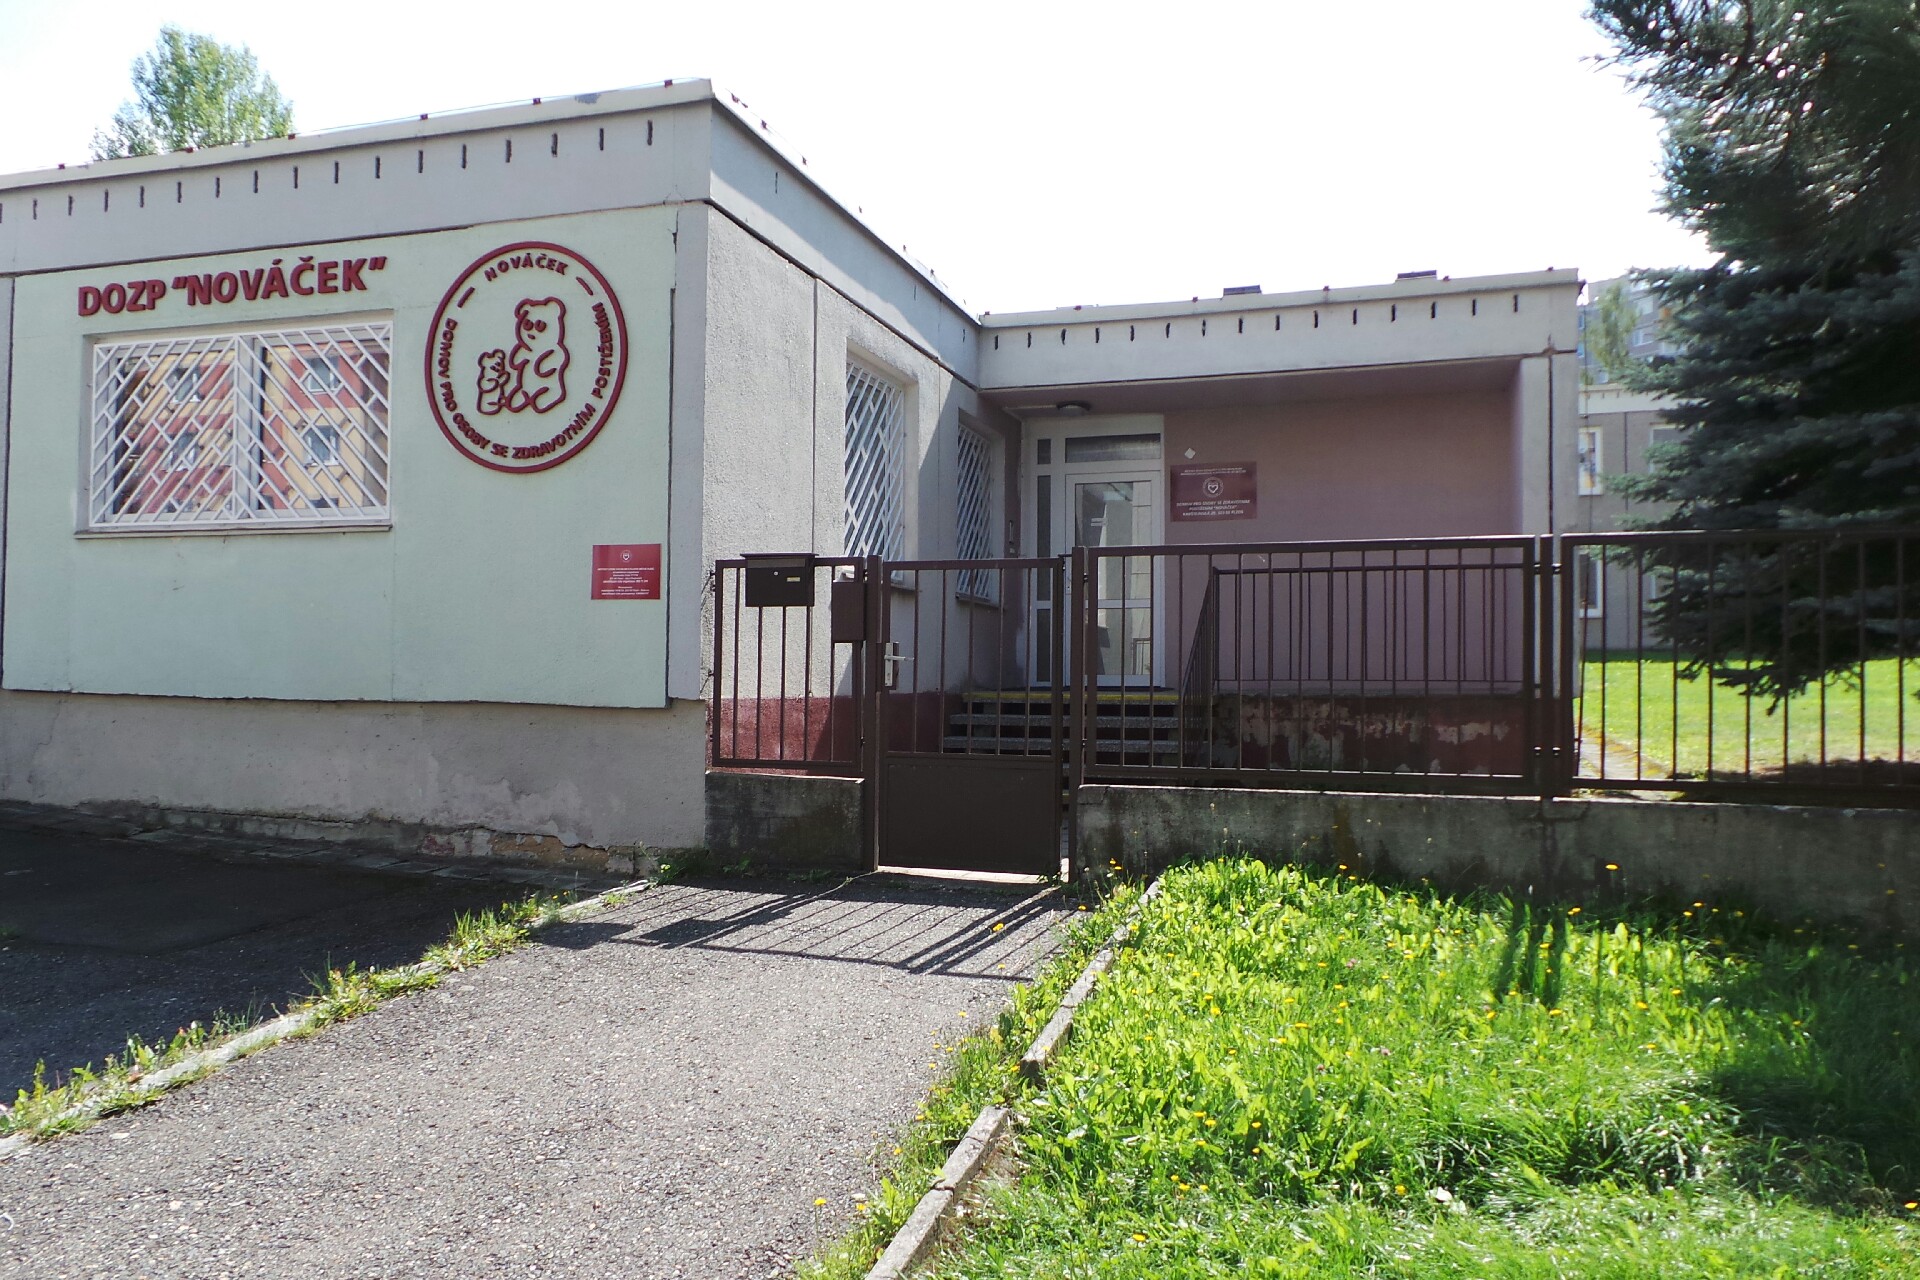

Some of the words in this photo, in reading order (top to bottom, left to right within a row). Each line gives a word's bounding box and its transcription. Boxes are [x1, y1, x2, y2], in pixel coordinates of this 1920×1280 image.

[484, 253, 569, 282] NOVÁČEK
[78, 279, 166, 317] DOZP
[438, 317, 458, 379] DOMOV
[590, 301, 614, 400] POSTIŽENÍM
[439, 381, 458, 412] PRO
[452, 412, 491, 450] OSOBY
[490, 442, 510, 458] SE
[511, 402, 597, 460] ZDRAVOTNÍM
